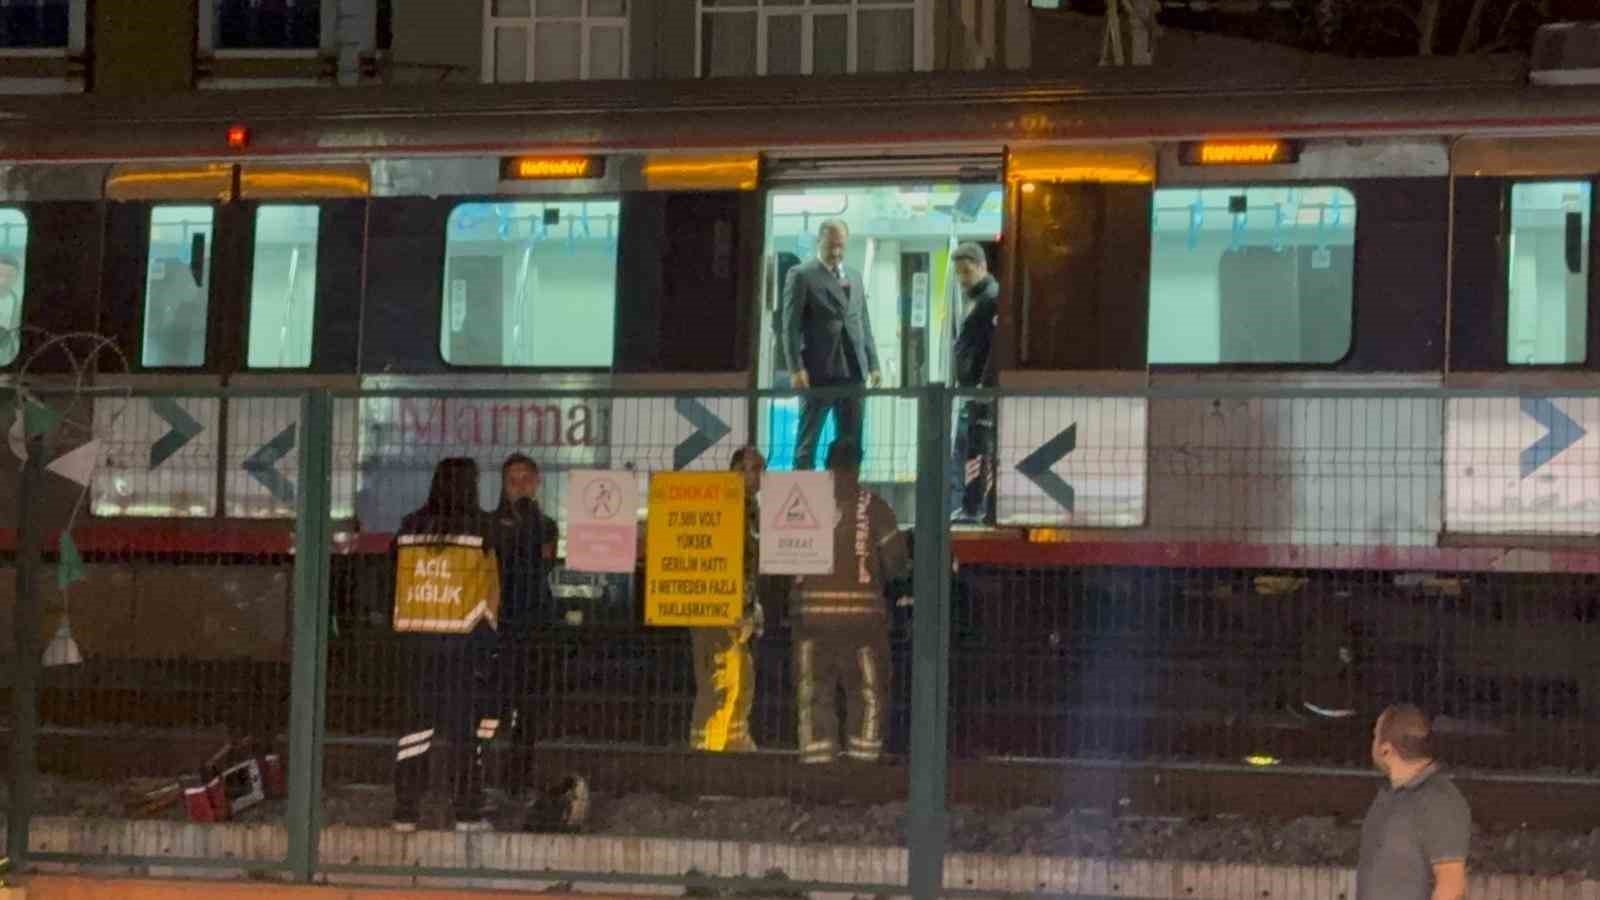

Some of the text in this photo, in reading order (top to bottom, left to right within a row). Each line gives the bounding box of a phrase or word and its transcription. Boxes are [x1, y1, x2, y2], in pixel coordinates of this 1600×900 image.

[699, 512, 722, 527] VOLT
[701, 557, 727, 571] HATTI
[659, 579, 706, 595] METREDEN
[709, 579, 736, 595] FAZLA
